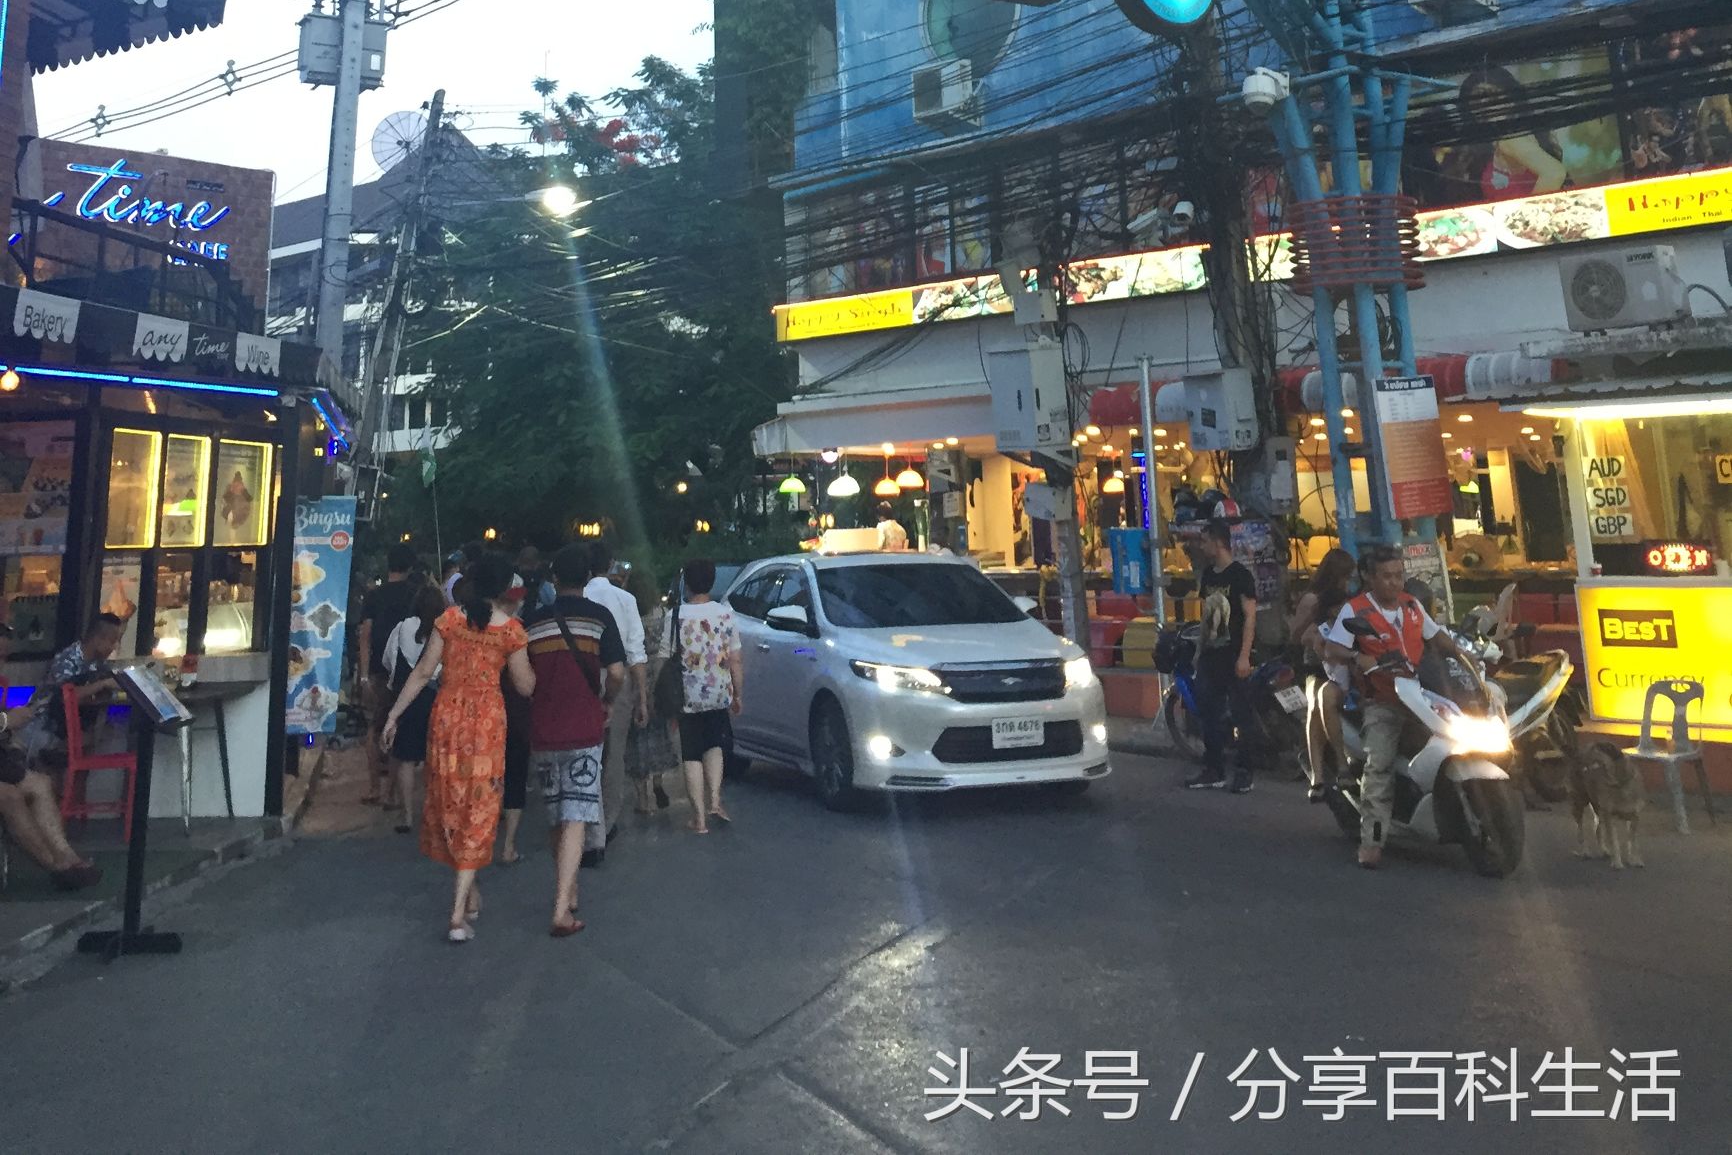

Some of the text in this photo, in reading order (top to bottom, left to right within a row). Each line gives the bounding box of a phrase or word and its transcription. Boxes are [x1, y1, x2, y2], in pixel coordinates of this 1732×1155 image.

[67, 158, 230, 231] time
[23, 305, 69, 335] Bakery
[143, 331, 230, 356] any time
[1589, 457, 1622, 478] AUD
[1593, 487, 1627, 508] SGD
[295, 505, 351, 533] Bingsu
[1595, 516, 1628, 535] GBP
[1649, 549, 1709, 567] OPEN
[1602, 617, 1673, 641] BEST
